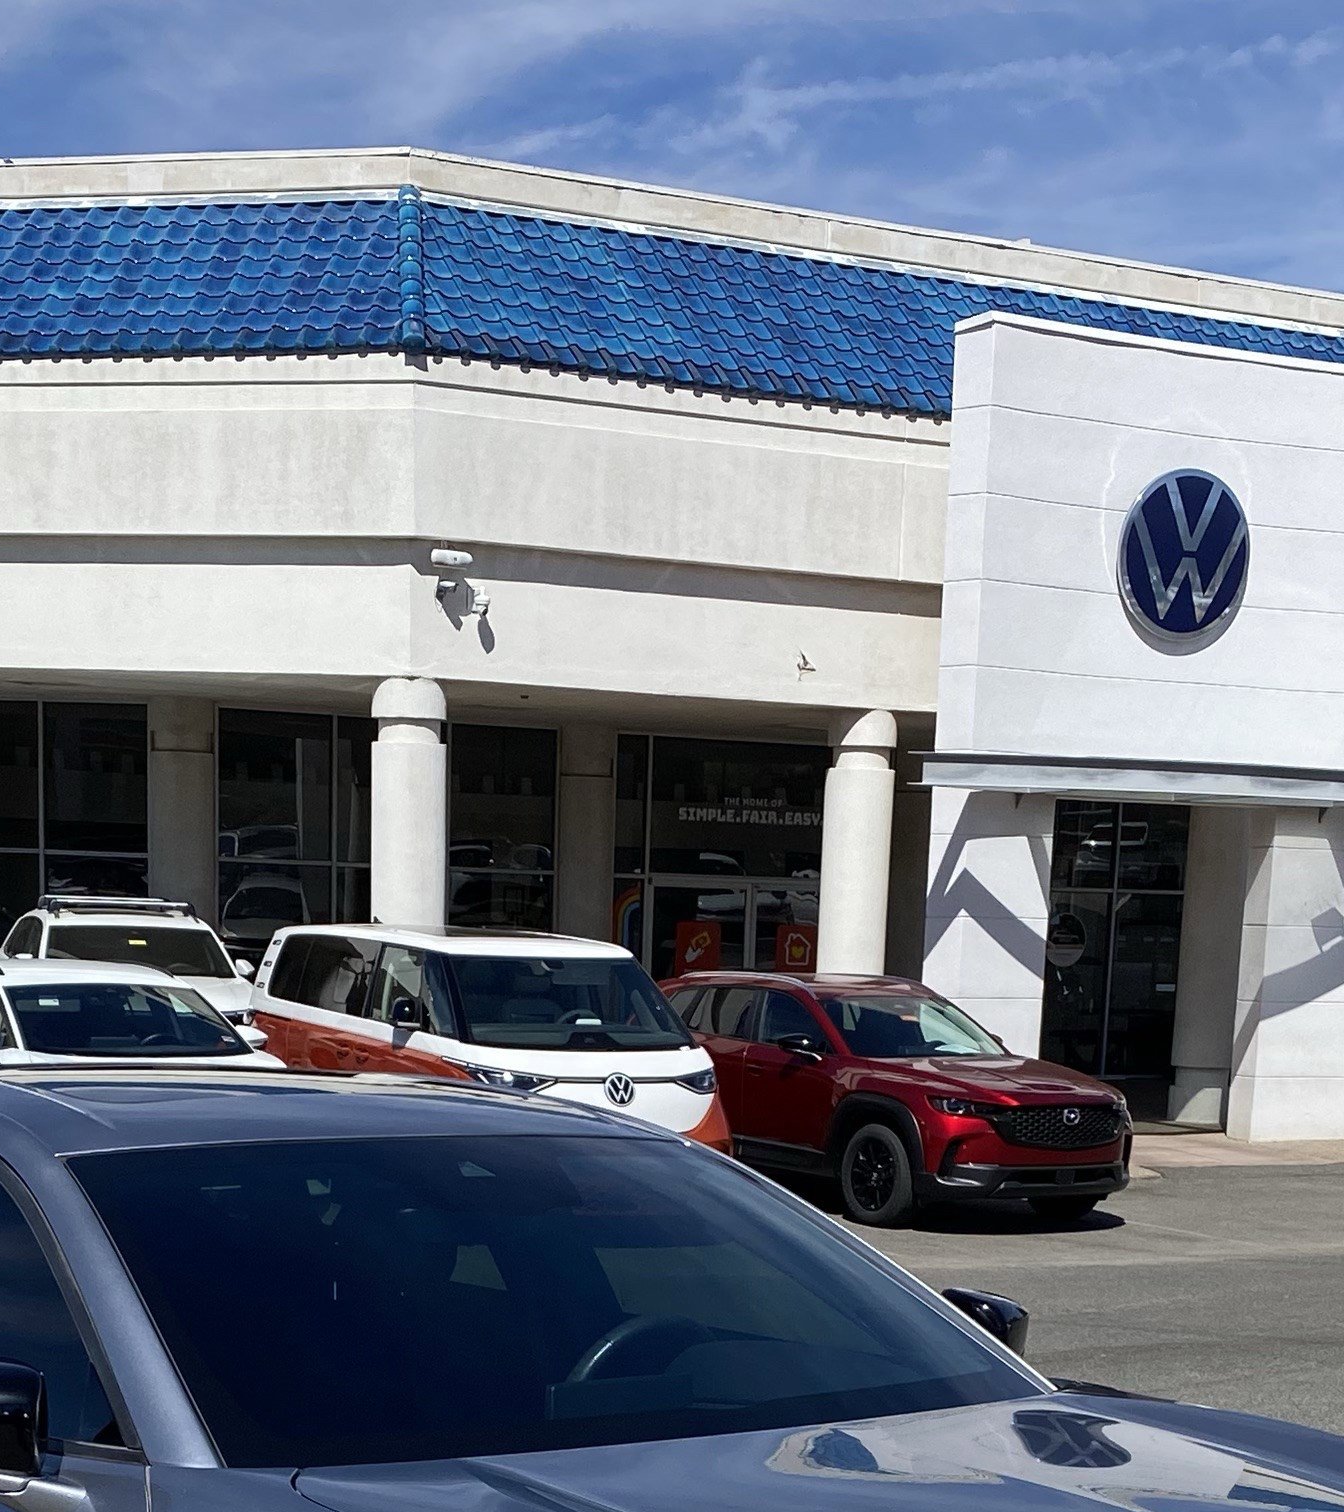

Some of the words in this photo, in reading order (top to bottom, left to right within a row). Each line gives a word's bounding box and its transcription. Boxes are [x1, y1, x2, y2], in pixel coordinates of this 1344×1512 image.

[1129, 472, 1249, 624] VW
[724, 797, 740, 806] THE
[742, 798, 768, 807] HOME
[770, 799, 783, 808] OF
[606, 1074, 634, 1104] VW
